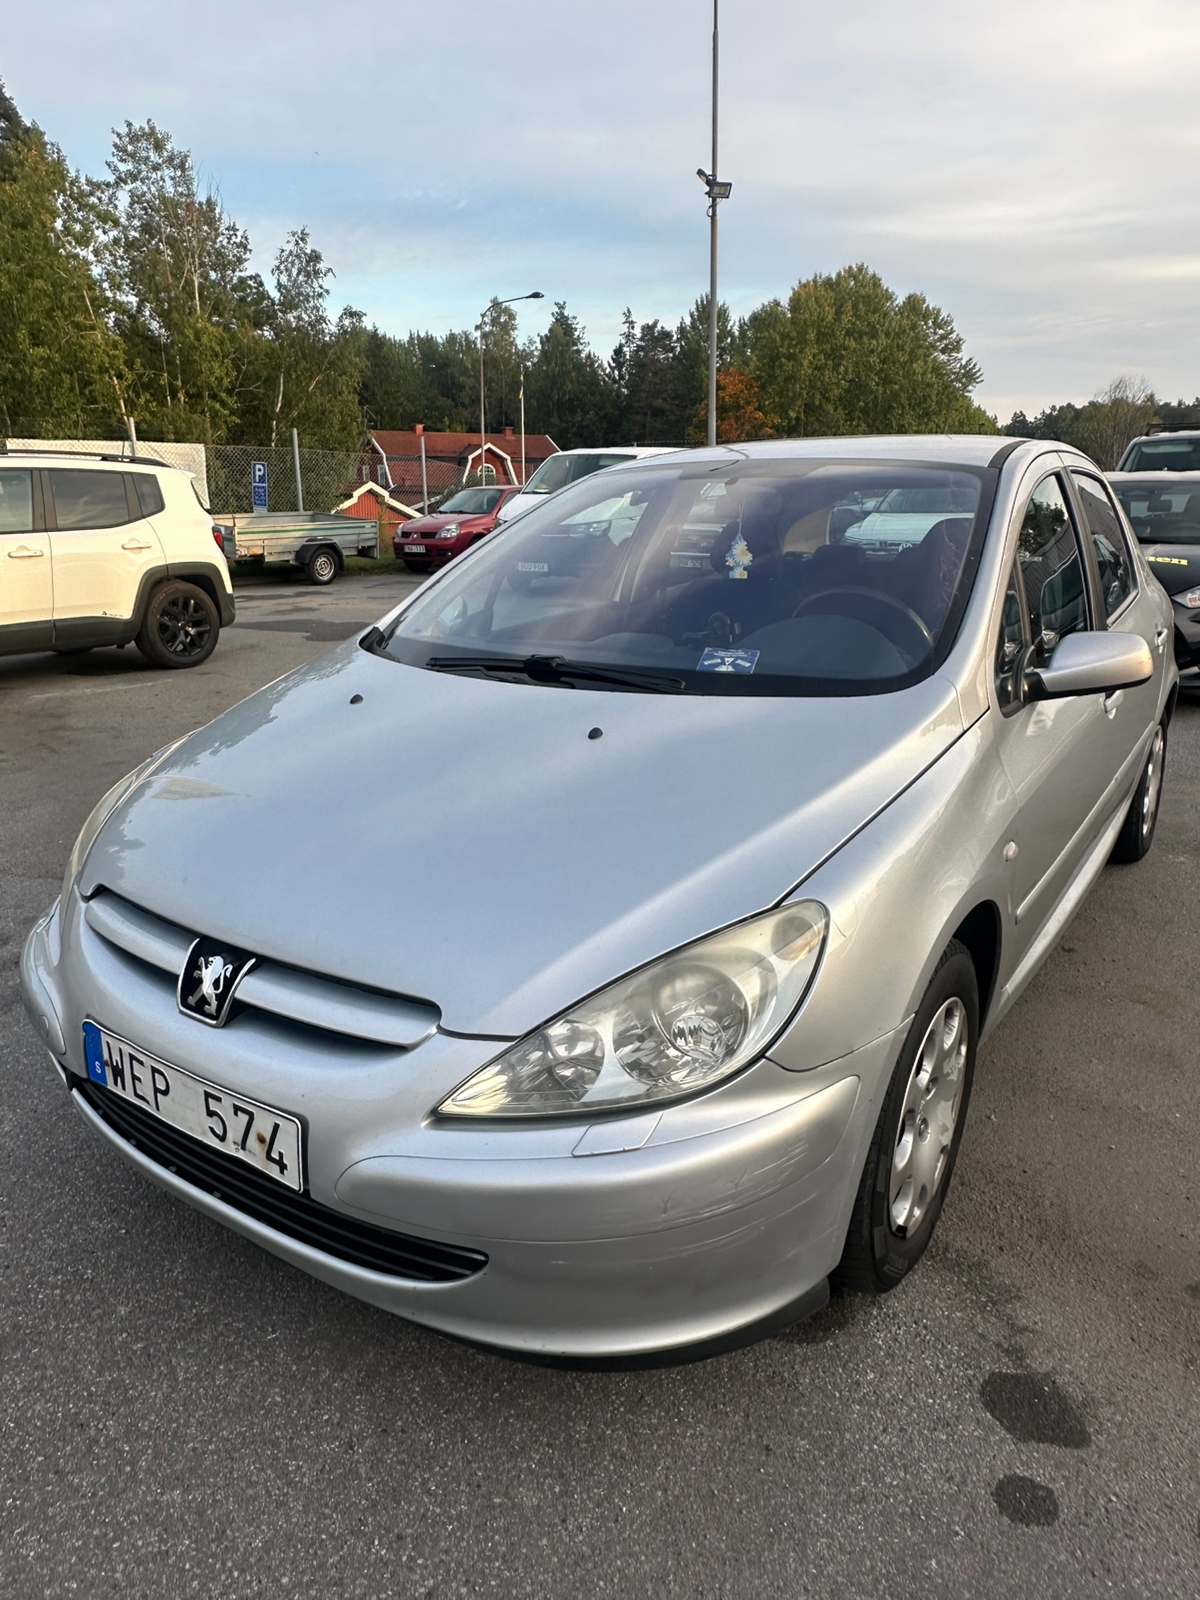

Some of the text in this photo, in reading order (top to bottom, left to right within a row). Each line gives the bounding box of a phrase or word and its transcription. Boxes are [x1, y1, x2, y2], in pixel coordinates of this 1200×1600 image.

[255, 464, 264, 482] P
[95, 1061, 101, 1074] S
[106, 1040, 288, 1175] WEP 574
